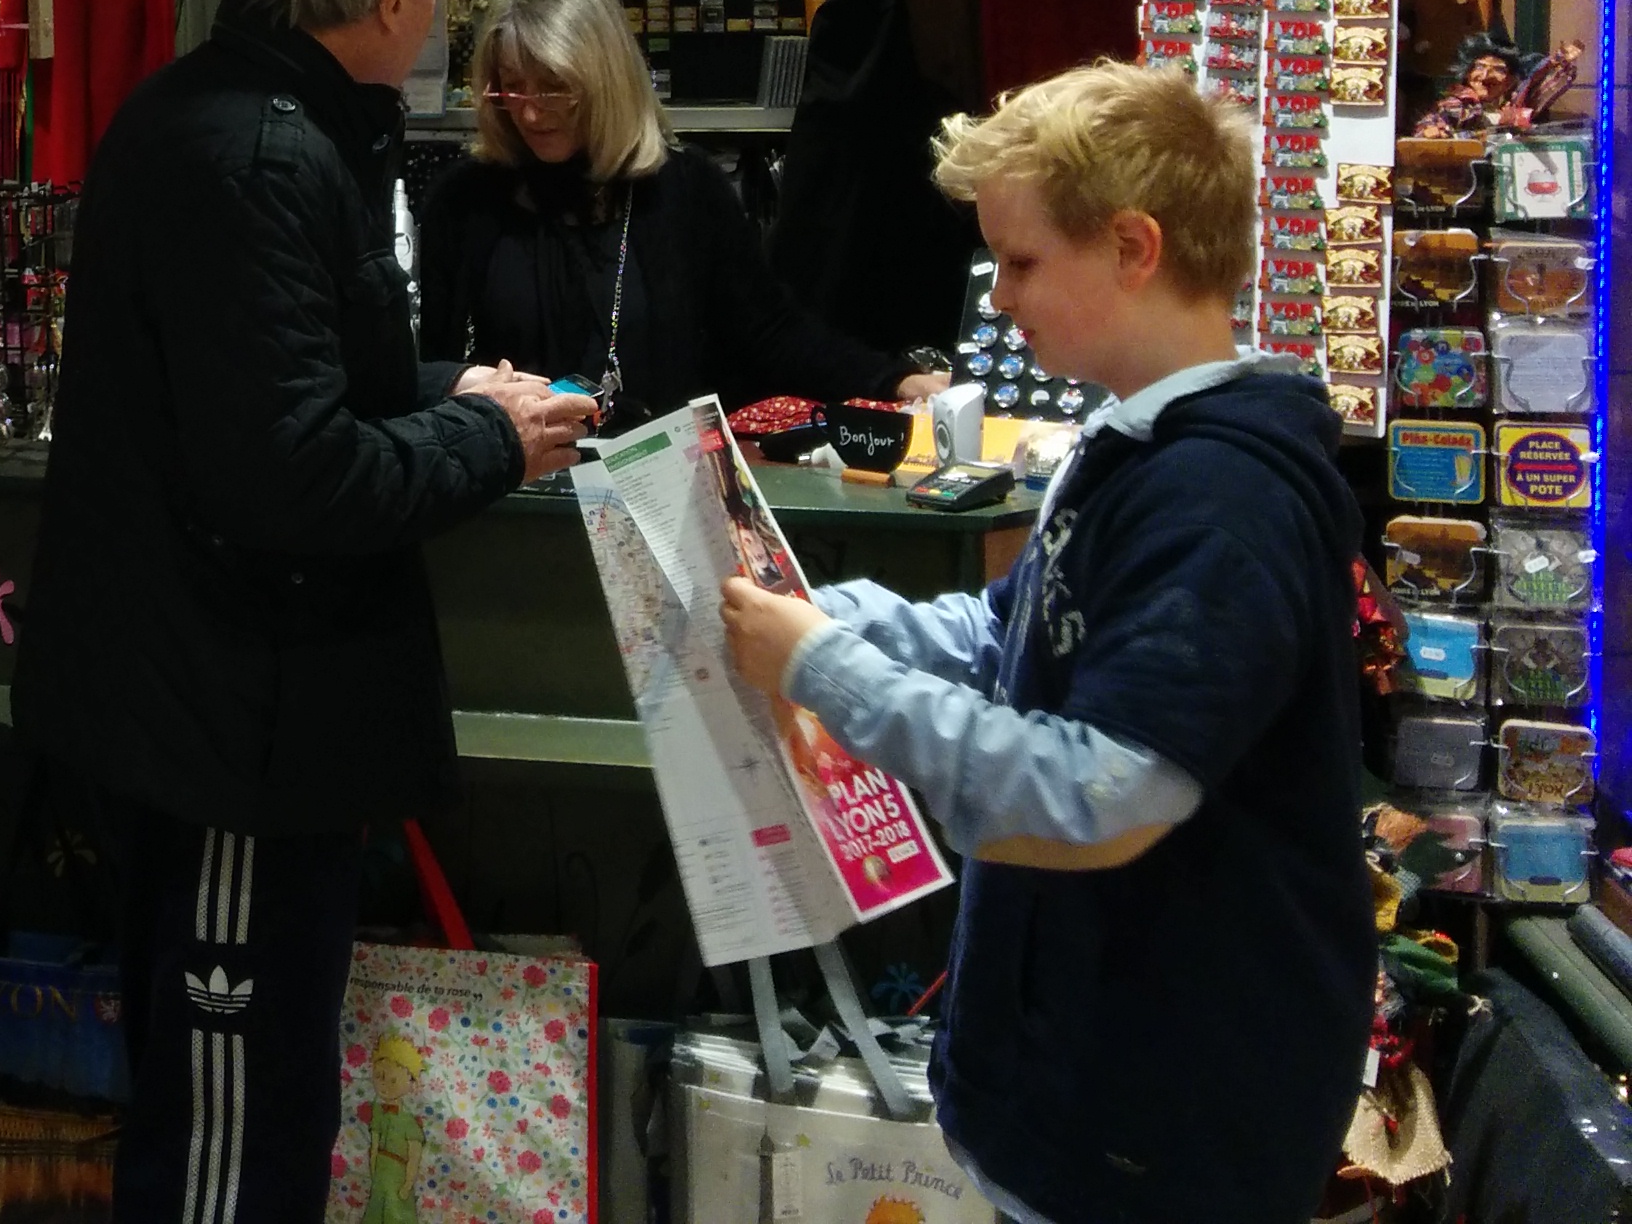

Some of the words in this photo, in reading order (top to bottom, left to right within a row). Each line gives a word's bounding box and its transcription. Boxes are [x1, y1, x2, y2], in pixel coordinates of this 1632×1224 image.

[839, 425, 895, 456] Bonjour
[1528, 441, 1561, 450] PLACE
[1526, 473, 1540, 482] UN
[1543, 474, 1576, 483] SUPER
[1529, 485, 1563, 495] POTE
[827, 767, 891, 810] PLAN
[350, 977, 415, 994] responsable
[417, 982, 431, 993] de
[849, 1157, 895, 1182] Petit
[902, 1159, 965, 1200] Prince
